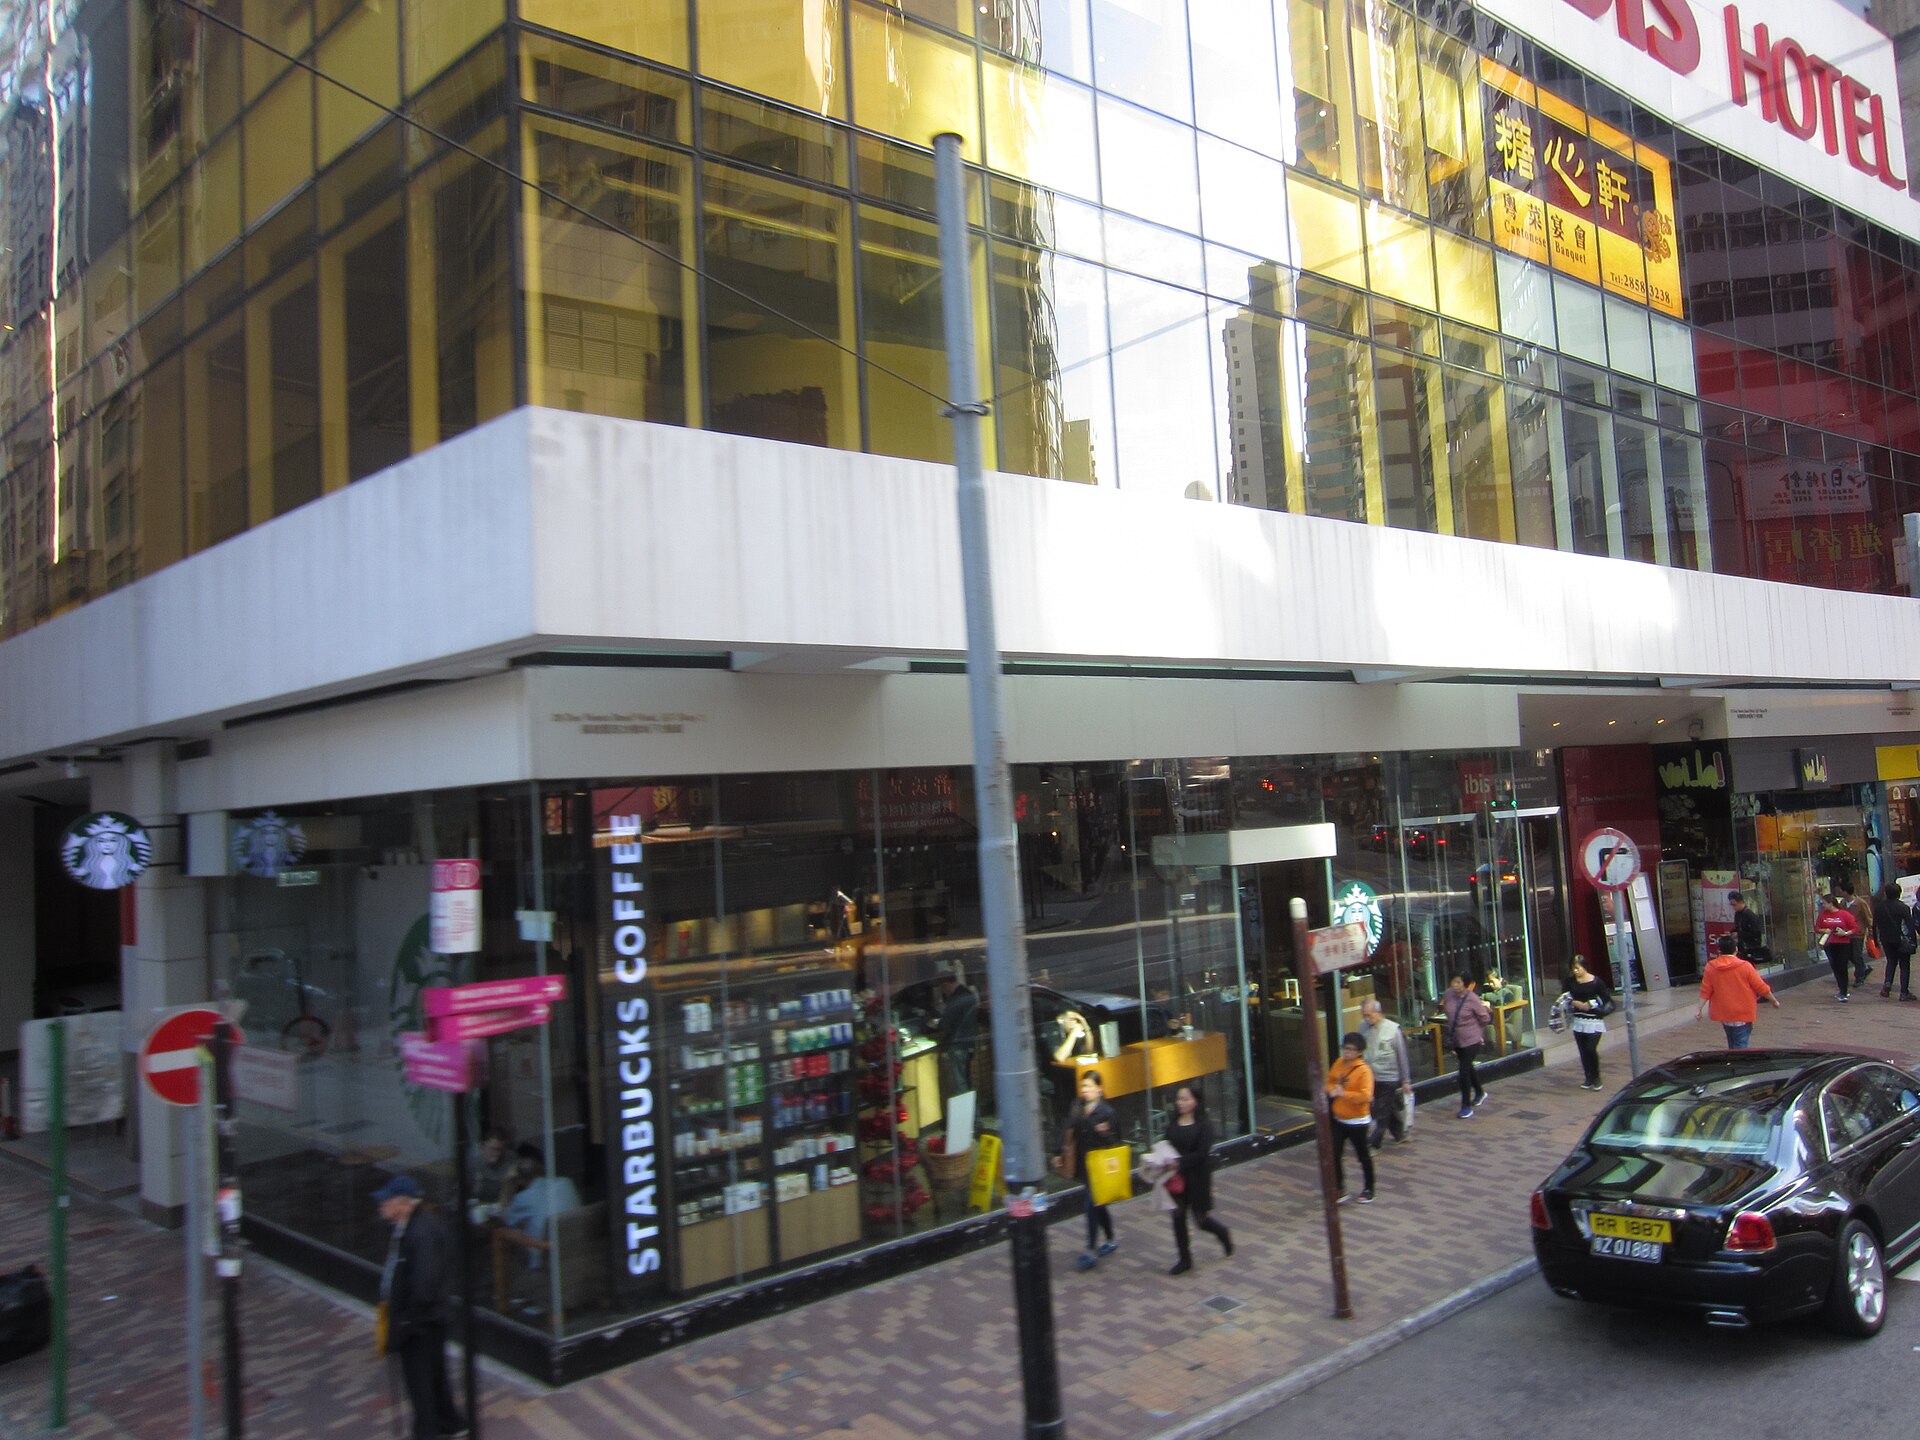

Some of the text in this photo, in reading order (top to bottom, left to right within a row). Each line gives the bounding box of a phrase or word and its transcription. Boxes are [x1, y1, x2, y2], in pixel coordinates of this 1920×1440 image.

[1723, 4, 1906, 191] HOTEL
[1504, 219, 1586, 265] Cantonese Banquet
[1464, 774, 1491, 795] ibis
[610, 814, 661, 1276] STARBUCKS COFFEE
